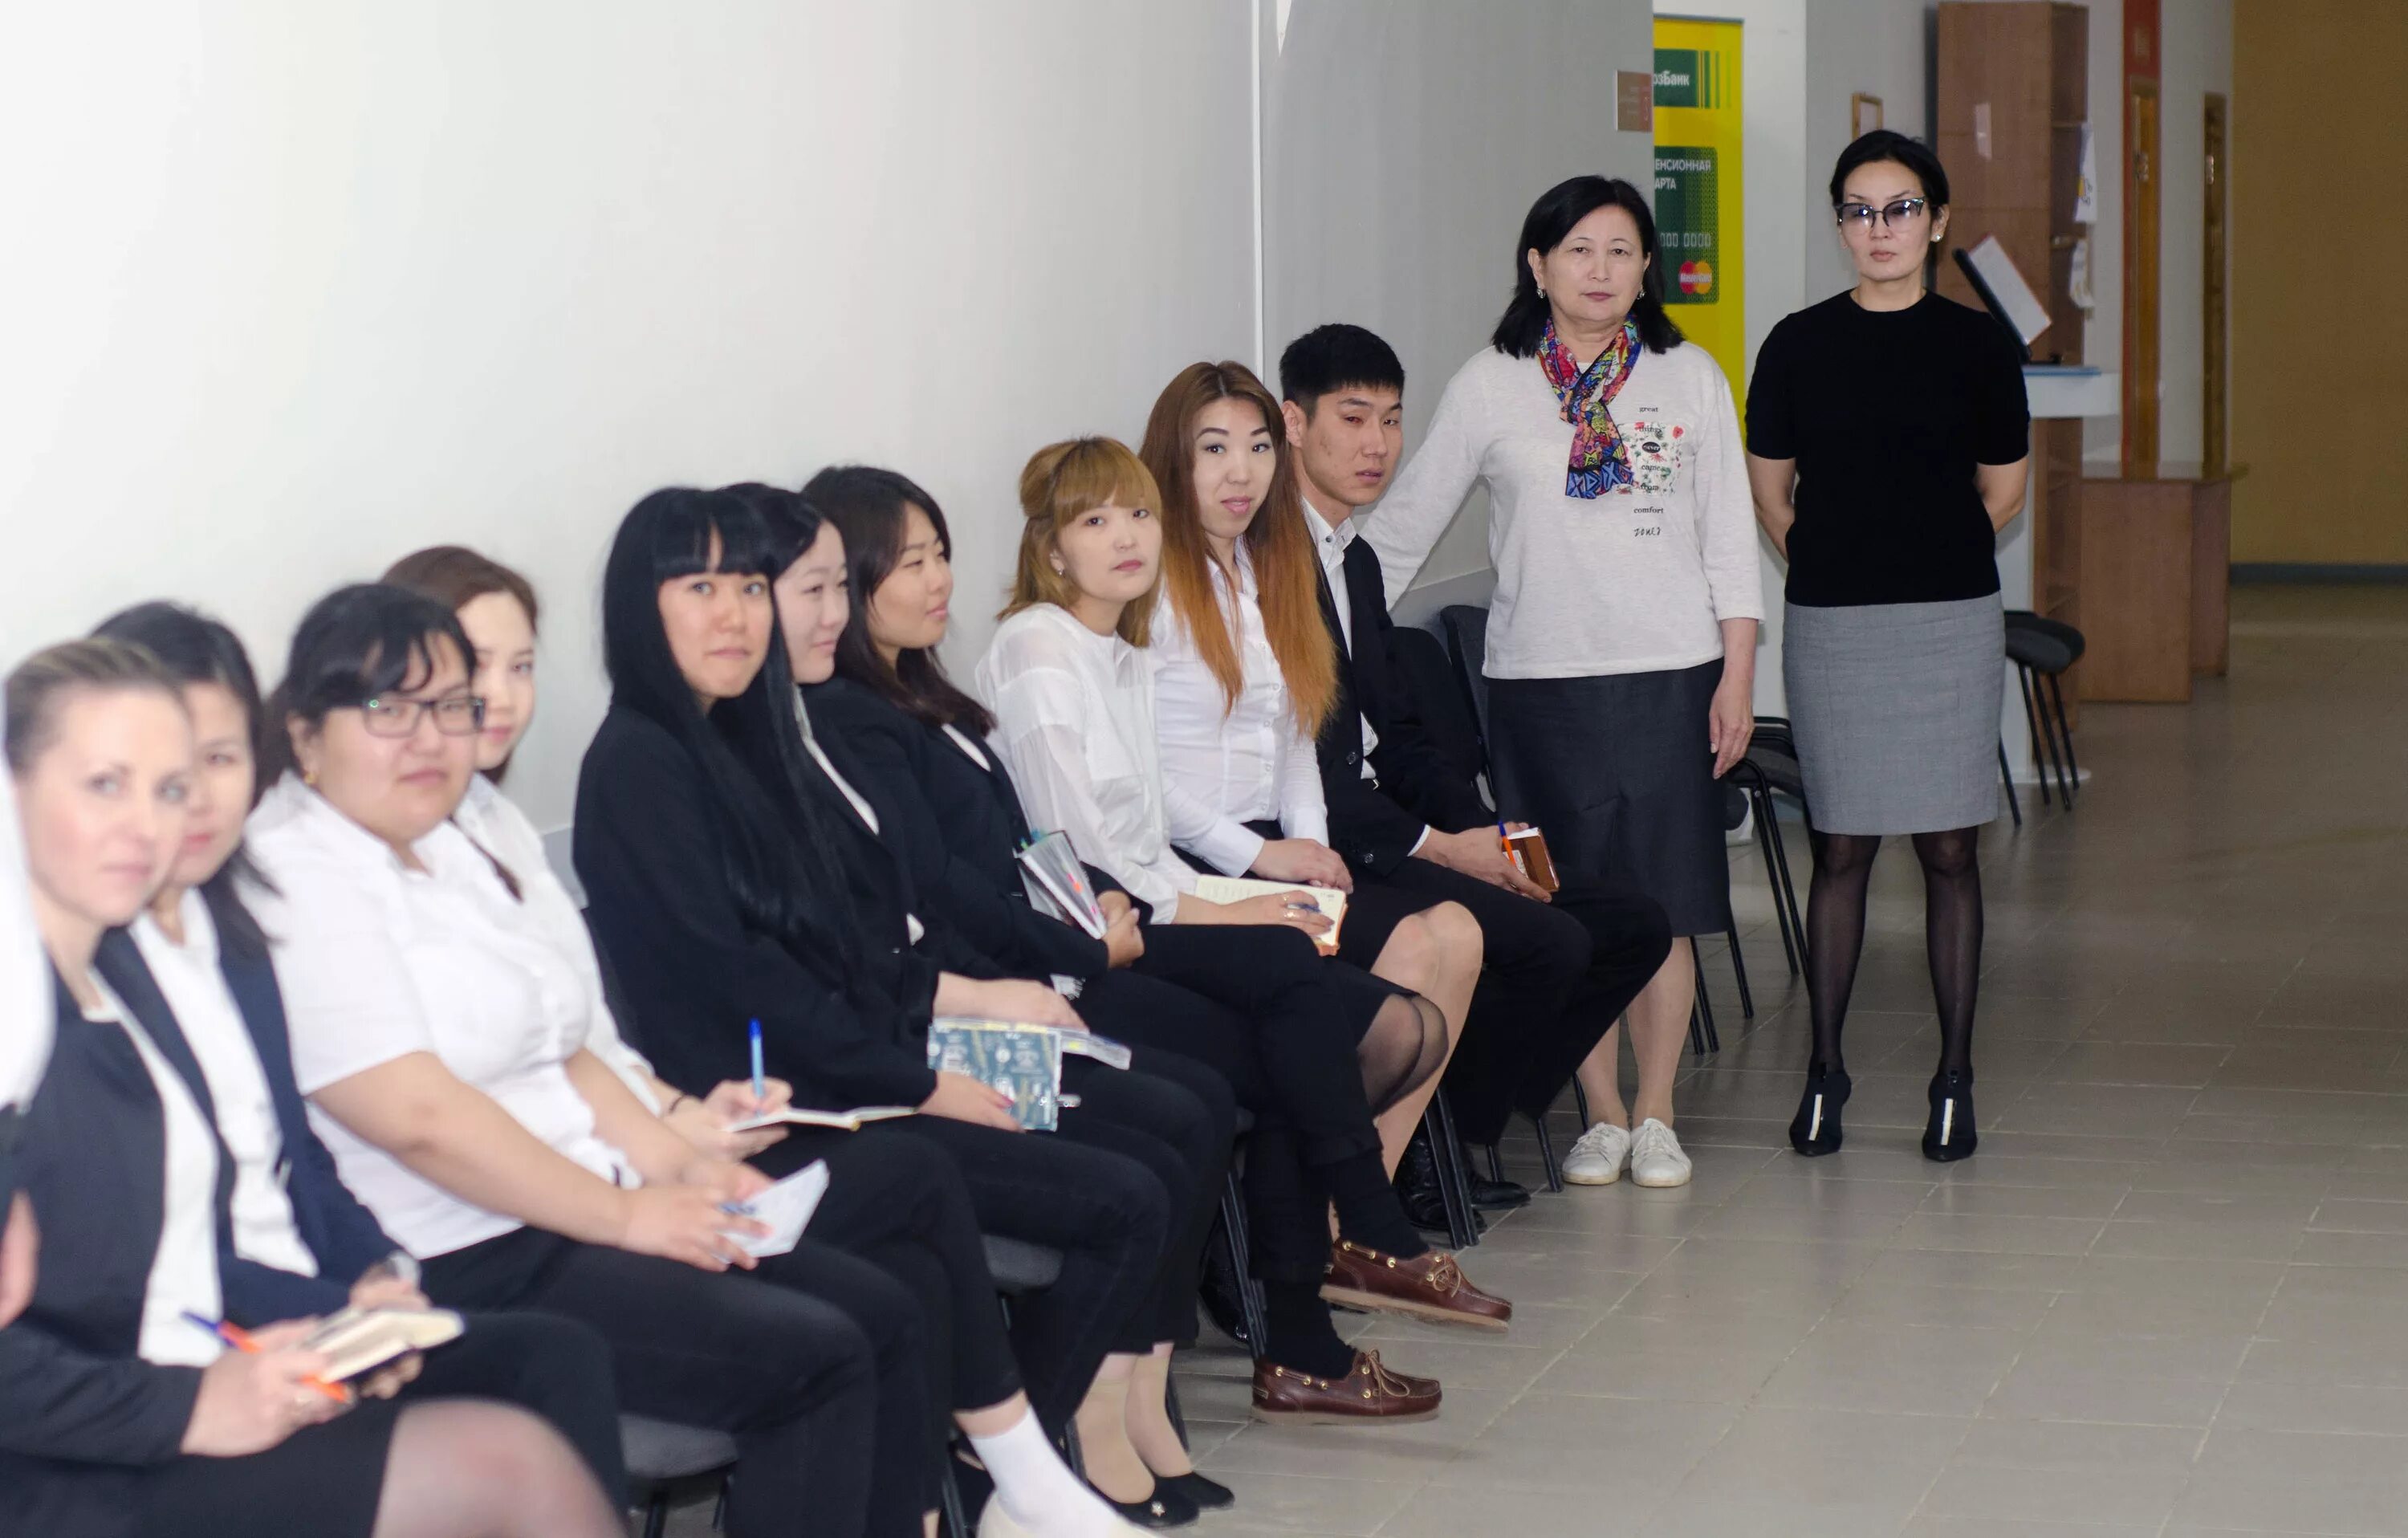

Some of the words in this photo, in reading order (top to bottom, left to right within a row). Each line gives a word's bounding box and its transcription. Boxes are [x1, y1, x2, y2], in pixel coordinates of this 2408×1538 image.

[1655, 159, 1711, 171] ЕНСИОННАЯ
[1654, 178, 1677, 189] АРТА
[1658, 232, 1678, 247] 000
[1684, 232, 1711, 247] 0000
